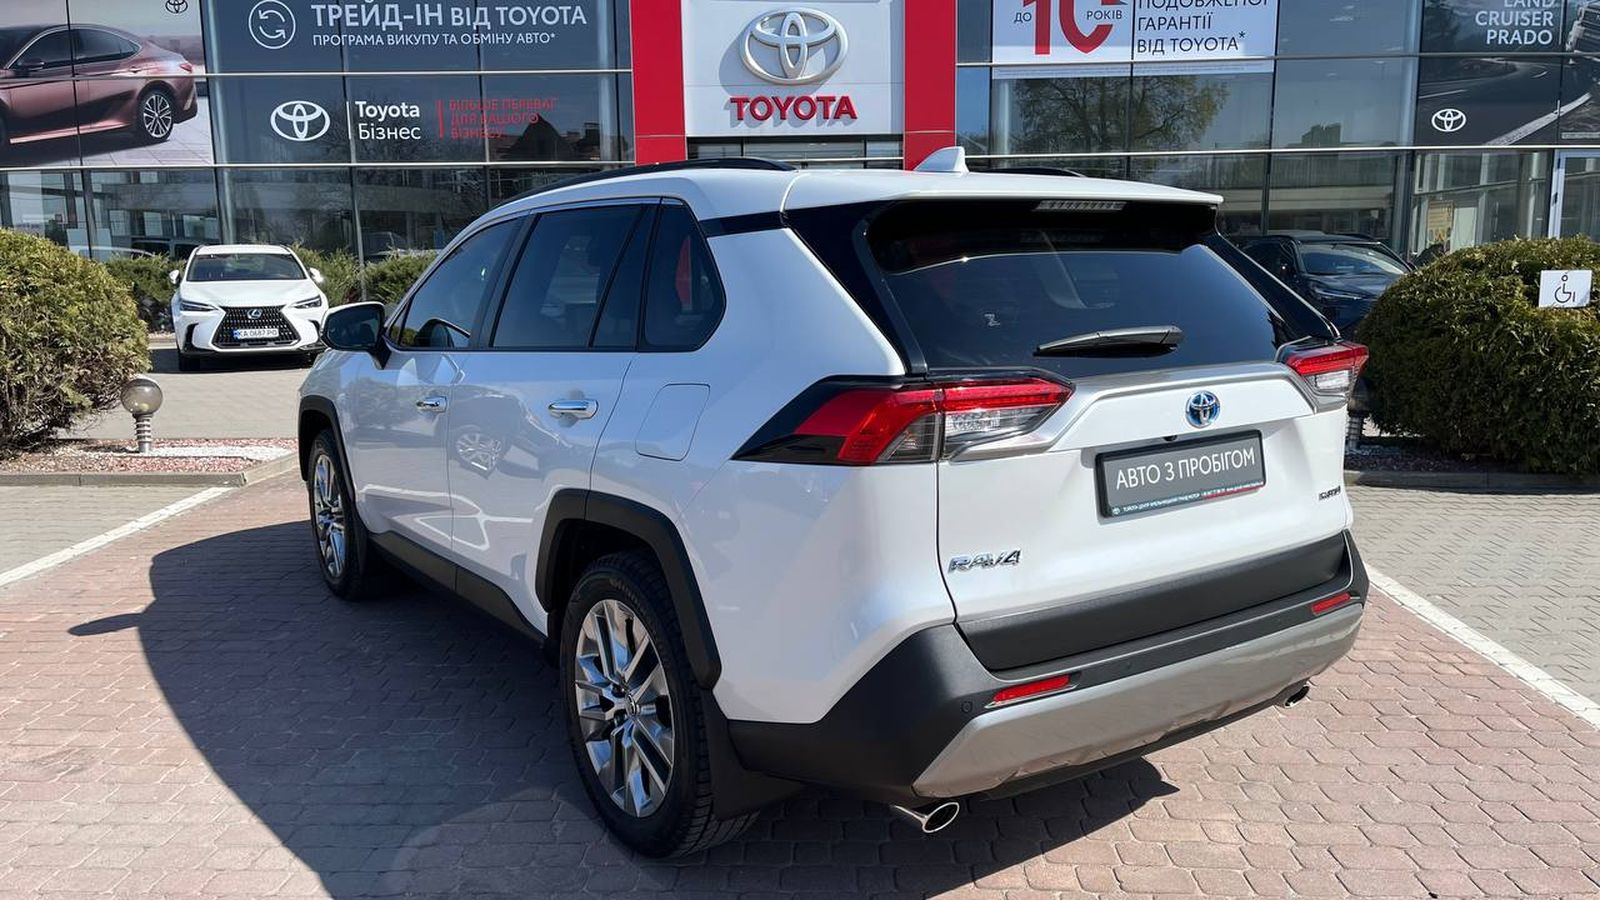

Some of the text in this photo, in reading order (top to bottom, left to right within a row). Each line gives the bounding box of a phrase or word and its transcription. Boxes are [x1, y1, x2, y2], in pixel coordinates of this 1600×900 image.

[311, 0, 587, 31] ТРЕЙД-ІН ВІД TOYOTA
[1014, 12, 1032, 23] ДО
[1086, 9, 1123, 20] РОКІВ
[1138, 12, 1214, 30] ГАРАНТІЇ
[1475, 10, 1554, 26] CRUISER
[313, 34, 384, 46] ПРОГРАМА
[387, 33, 440, 45] ВИКУПУ
[442, 33, 458, 45] ТА
[461, 33, 513, 44] ОБМІНУ
[1486, 29, 1553, 45] PRADO
[1137, 39, 1164, 55] ВІД
[355, 101, 420, 122] Toyota
[730, 95, 858, 121] TOYOTA
[358, 123, 421, 140] Бізнес
[1116, 466, 1161, 490] АВТО
[1178, 447, 1255, 479] ПРОБІГОМ
[947, 549, 1021, 574] RAV4
